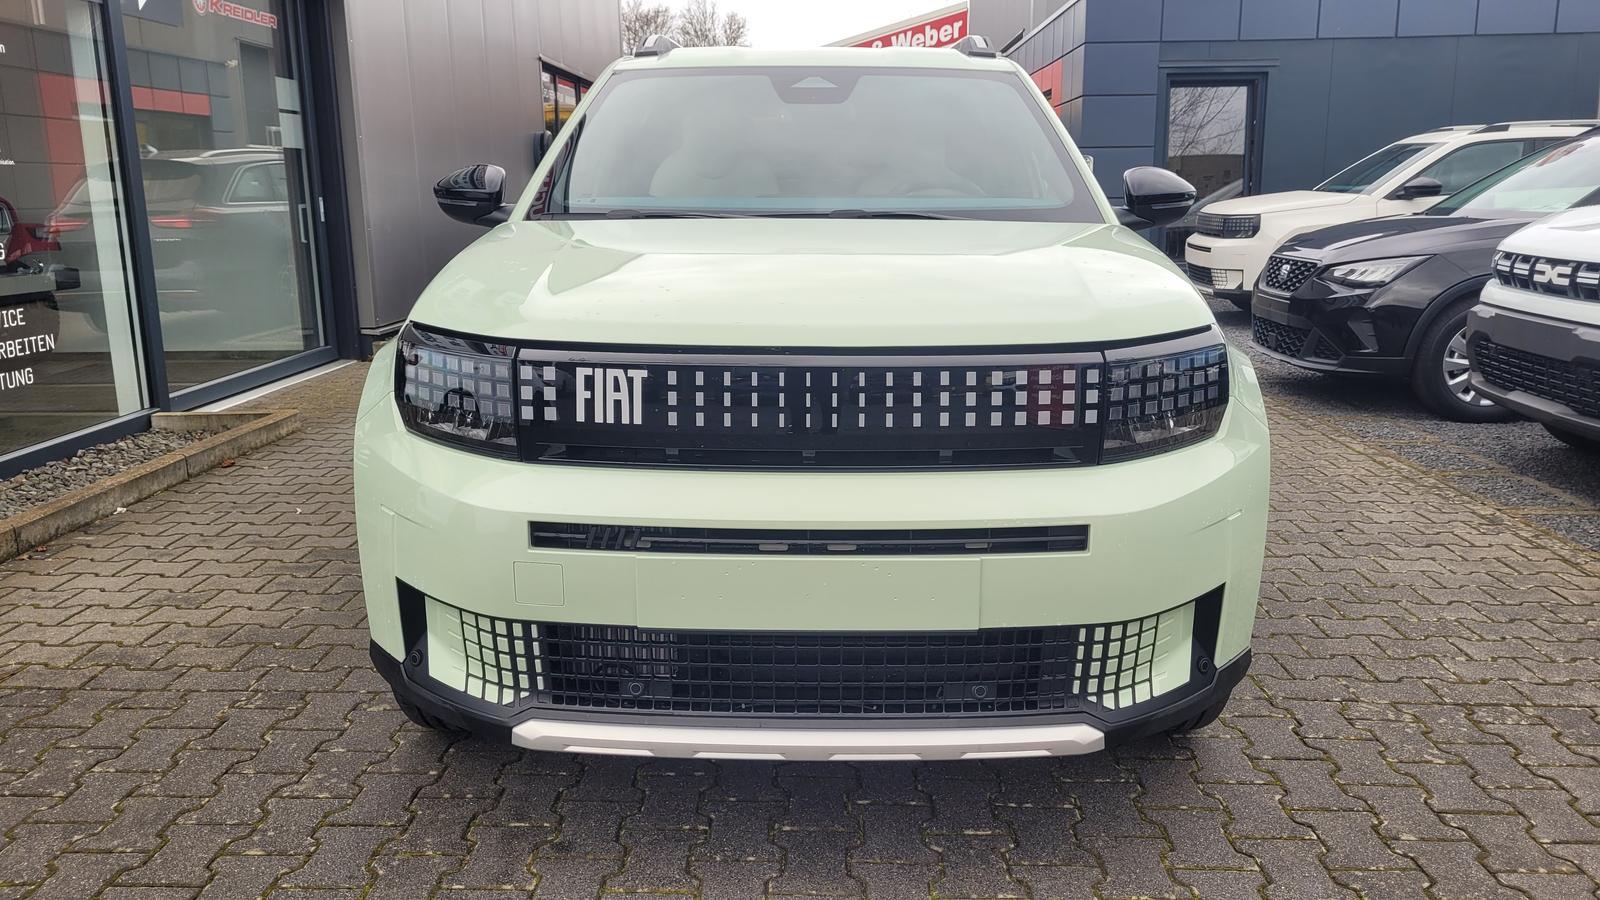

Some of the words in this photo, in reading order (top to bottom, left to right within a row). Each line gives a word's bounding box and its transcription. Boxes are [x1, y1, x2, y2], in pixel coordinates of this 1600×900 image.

[208, 0, 278, 28] KREIDLER
[890, 20, 963, 48] Weber
[575, 366, 648, 425] FIAT
